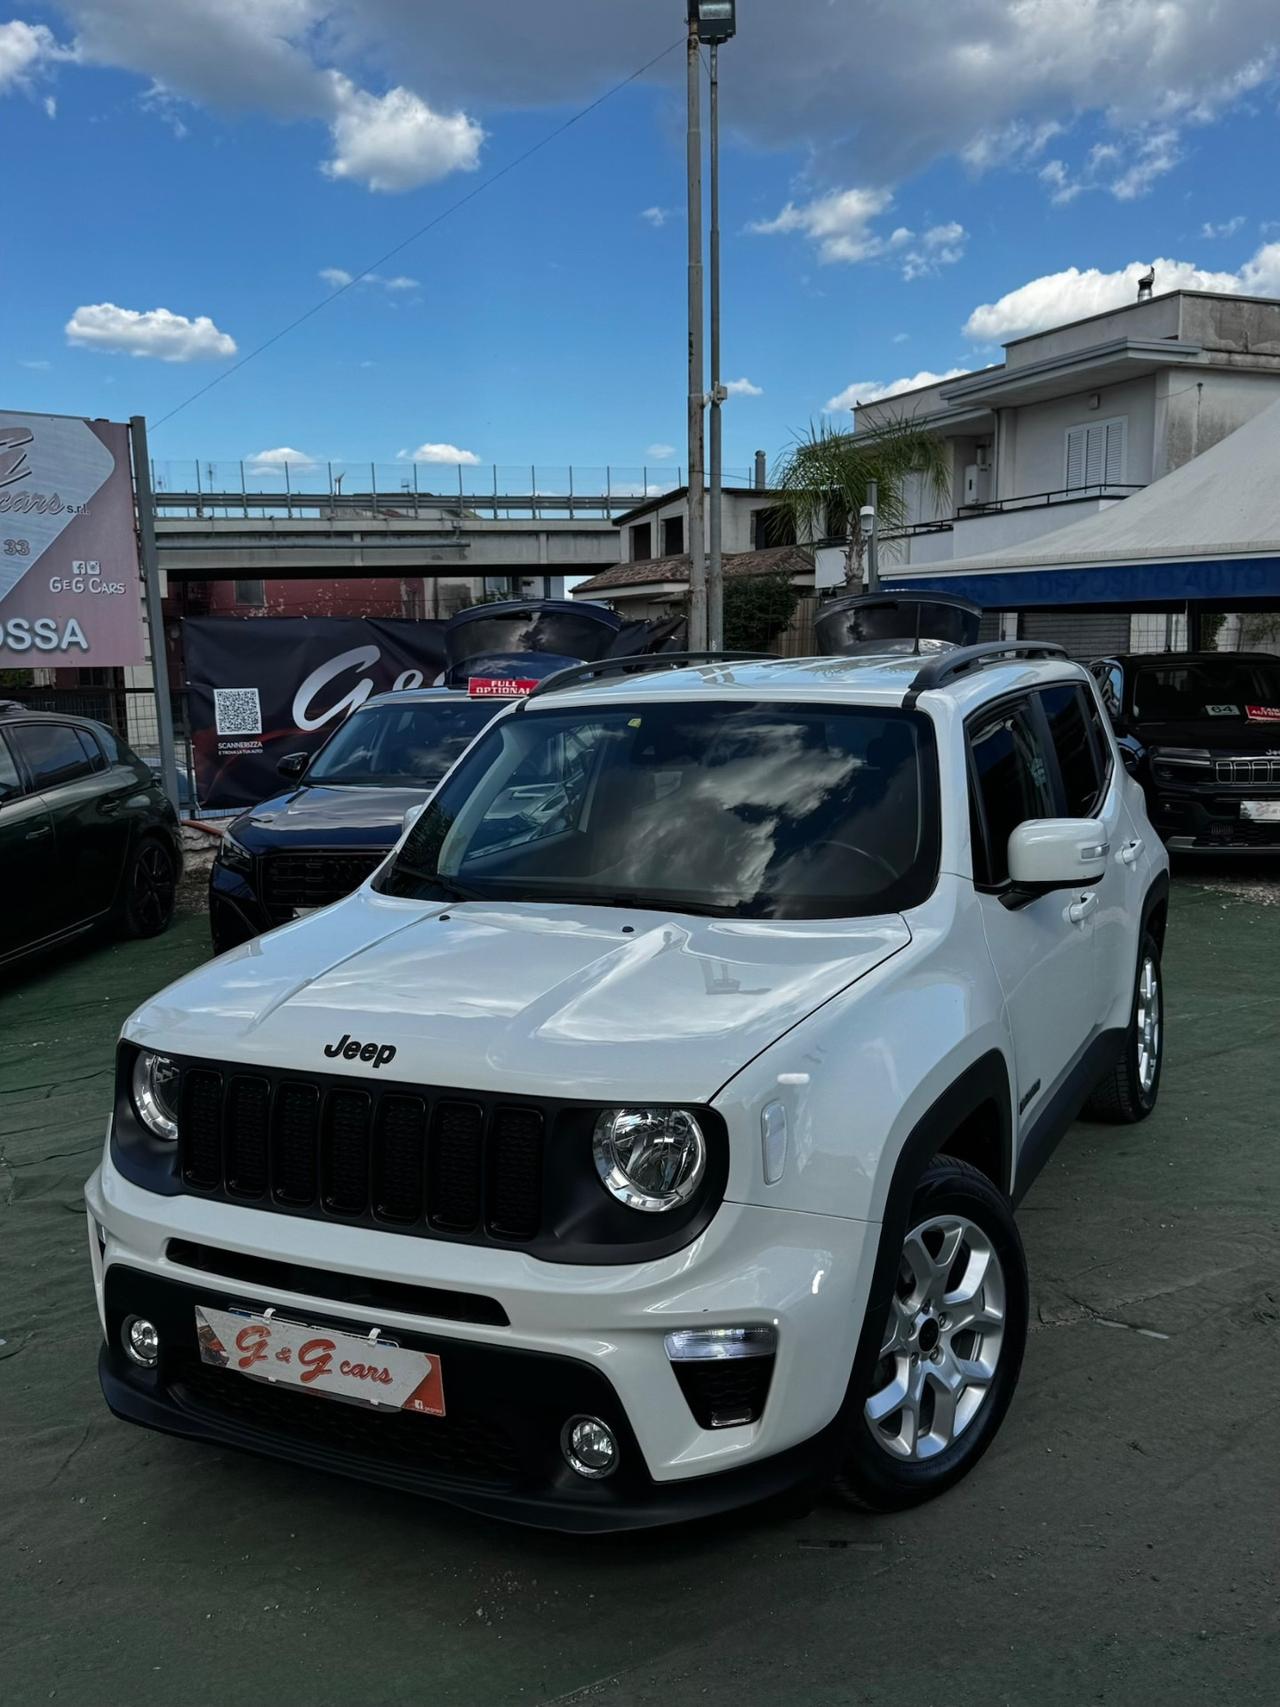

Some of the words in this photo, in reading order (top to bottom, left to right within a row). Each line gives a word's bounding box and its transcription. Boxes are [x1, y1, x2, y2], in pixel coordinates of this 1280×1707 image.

[3, 539, 30, 556] 33
[0, 617, 89, 650] SSA
[217, 741, 263, 750] SCANNERIZZA
[324, 1034, 397, 1068] Jeep
[339, 1359, 393, 1385] cars
